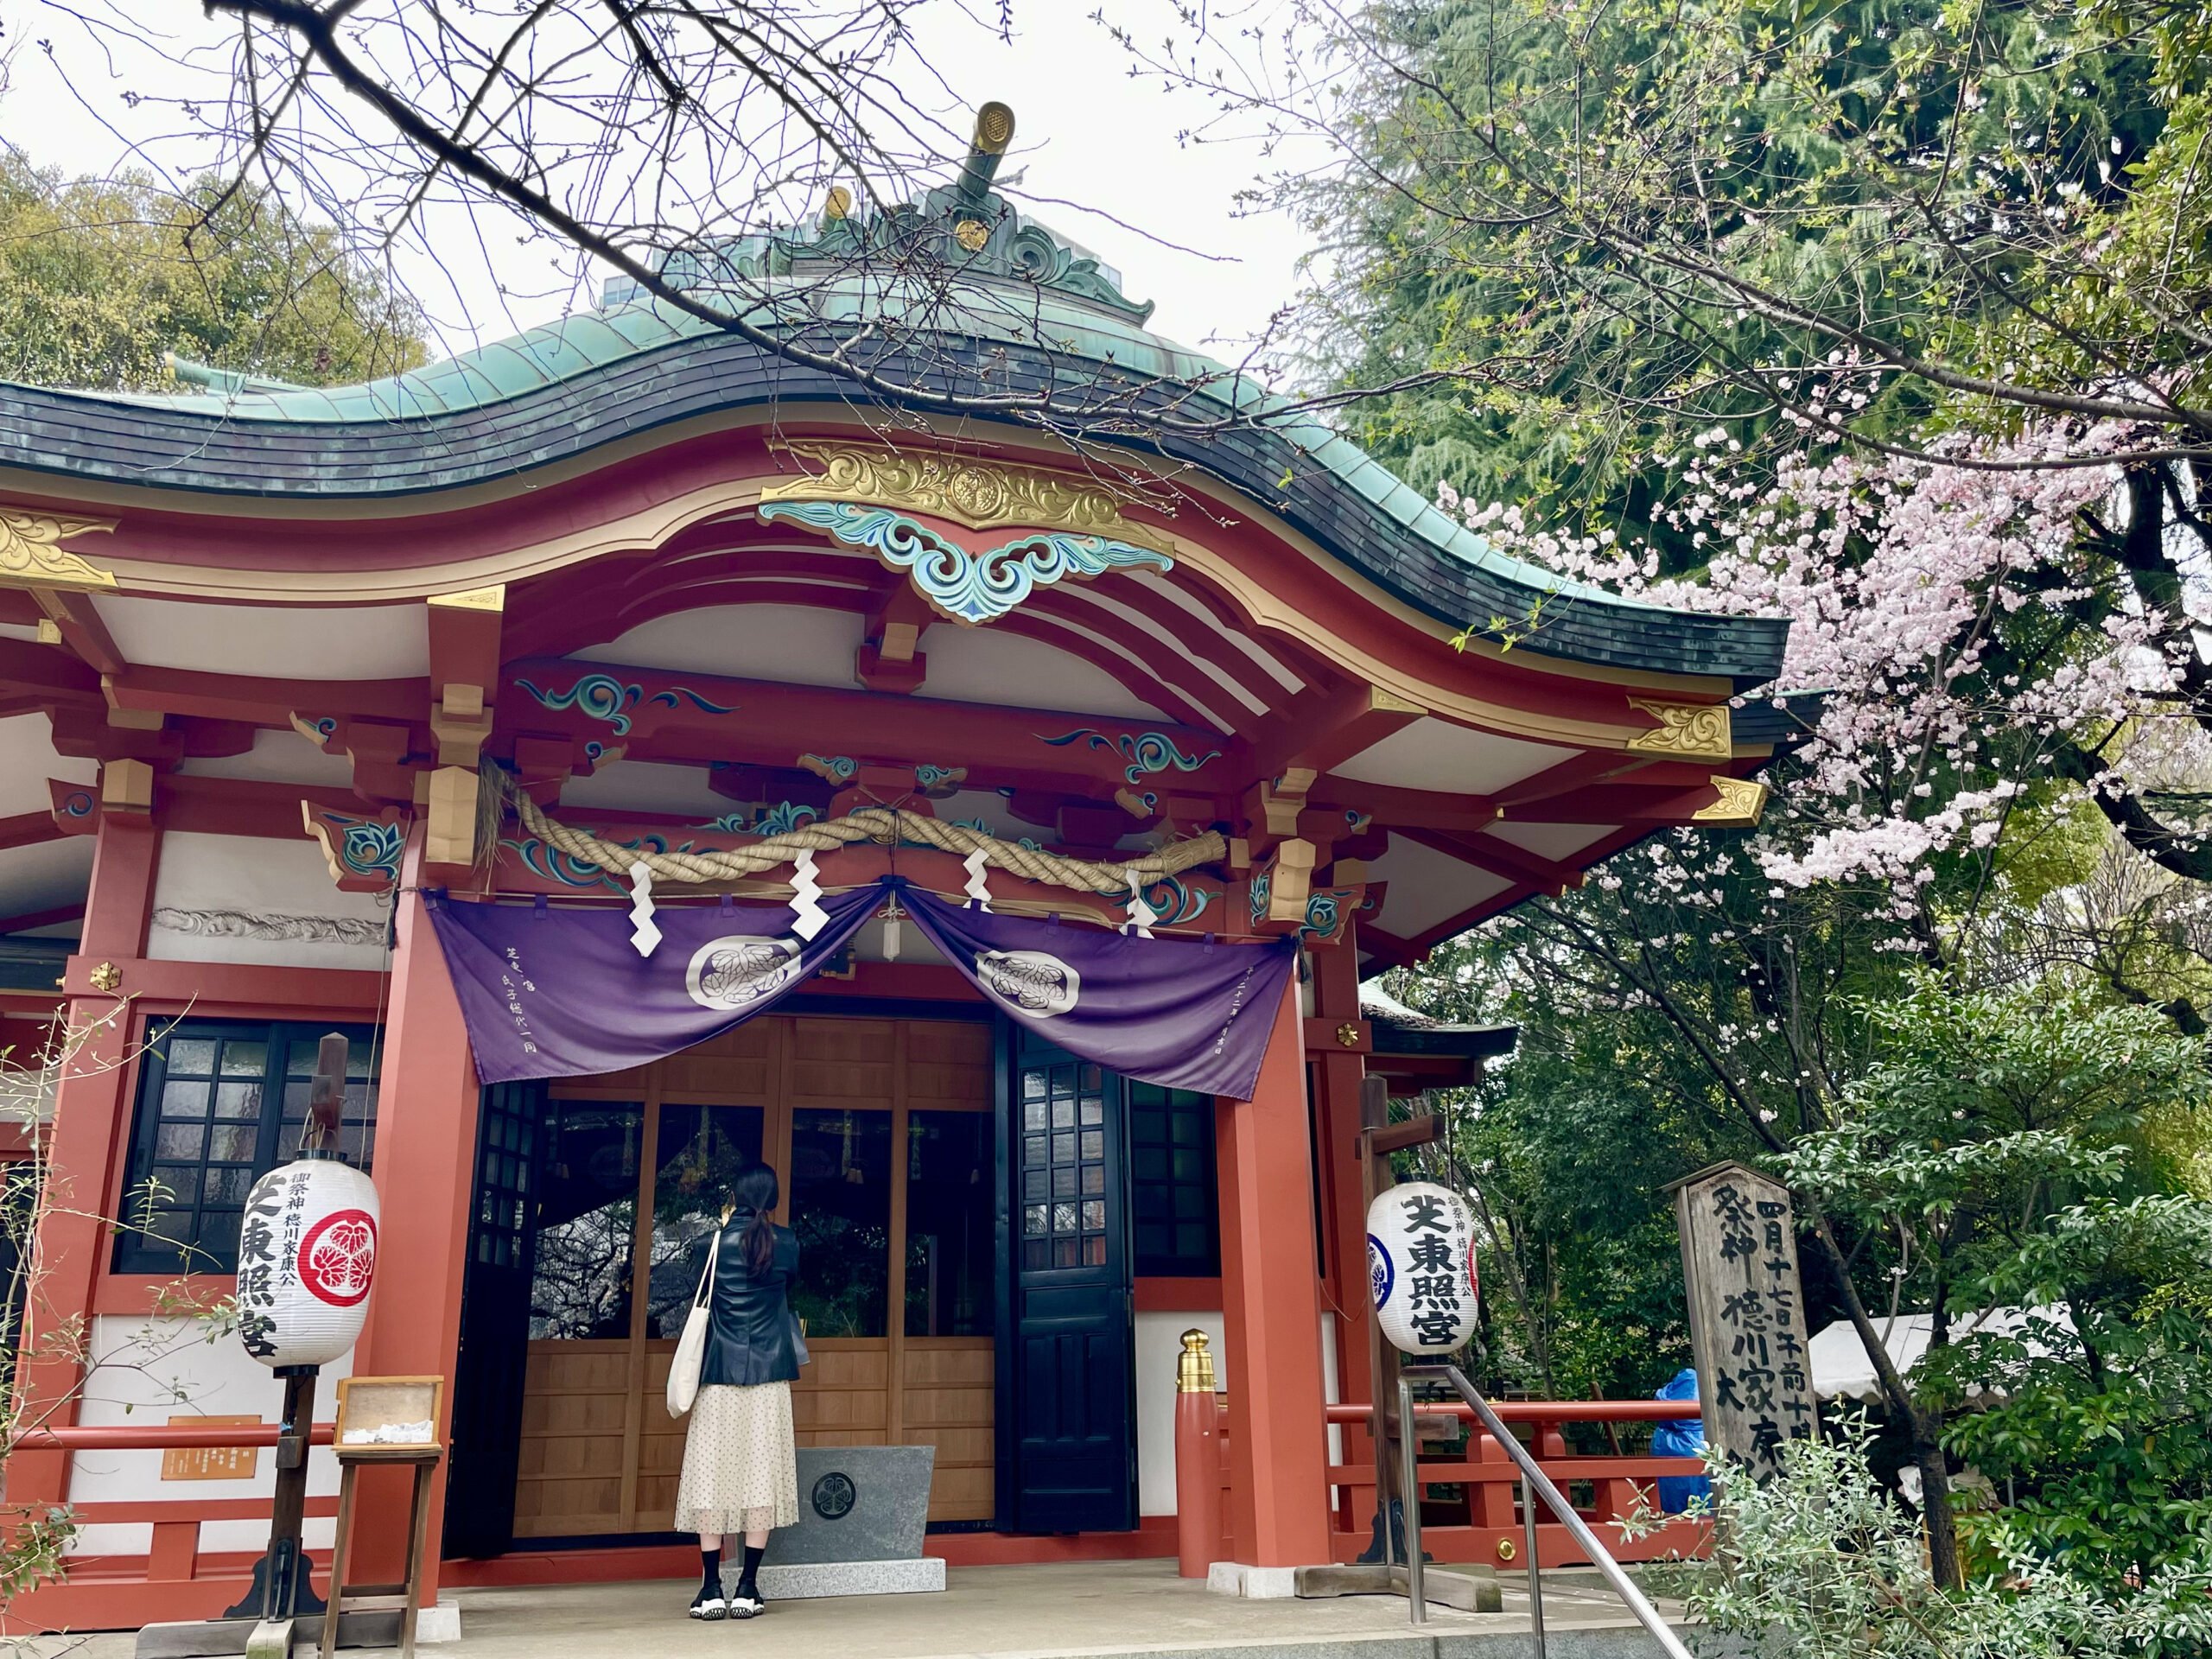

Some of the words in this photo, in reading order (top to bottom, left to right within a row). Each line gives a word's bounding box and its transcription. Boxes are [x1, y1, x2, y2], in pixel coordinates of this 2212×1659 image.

[506, 947, 536, 992] 芝東宮
[502, 975, 537, 1053] 氏子総代一同
[286, 1173, 311, 1210] 御祭神
[236, 1174, 288, 1358] 芝東照宮
[279, 1213, 302, 1287] 徳川家康公
[1401, 1194, 1461, 1346] 芝東照宮
[1712, 1183, 1758, 1286] 祭神
